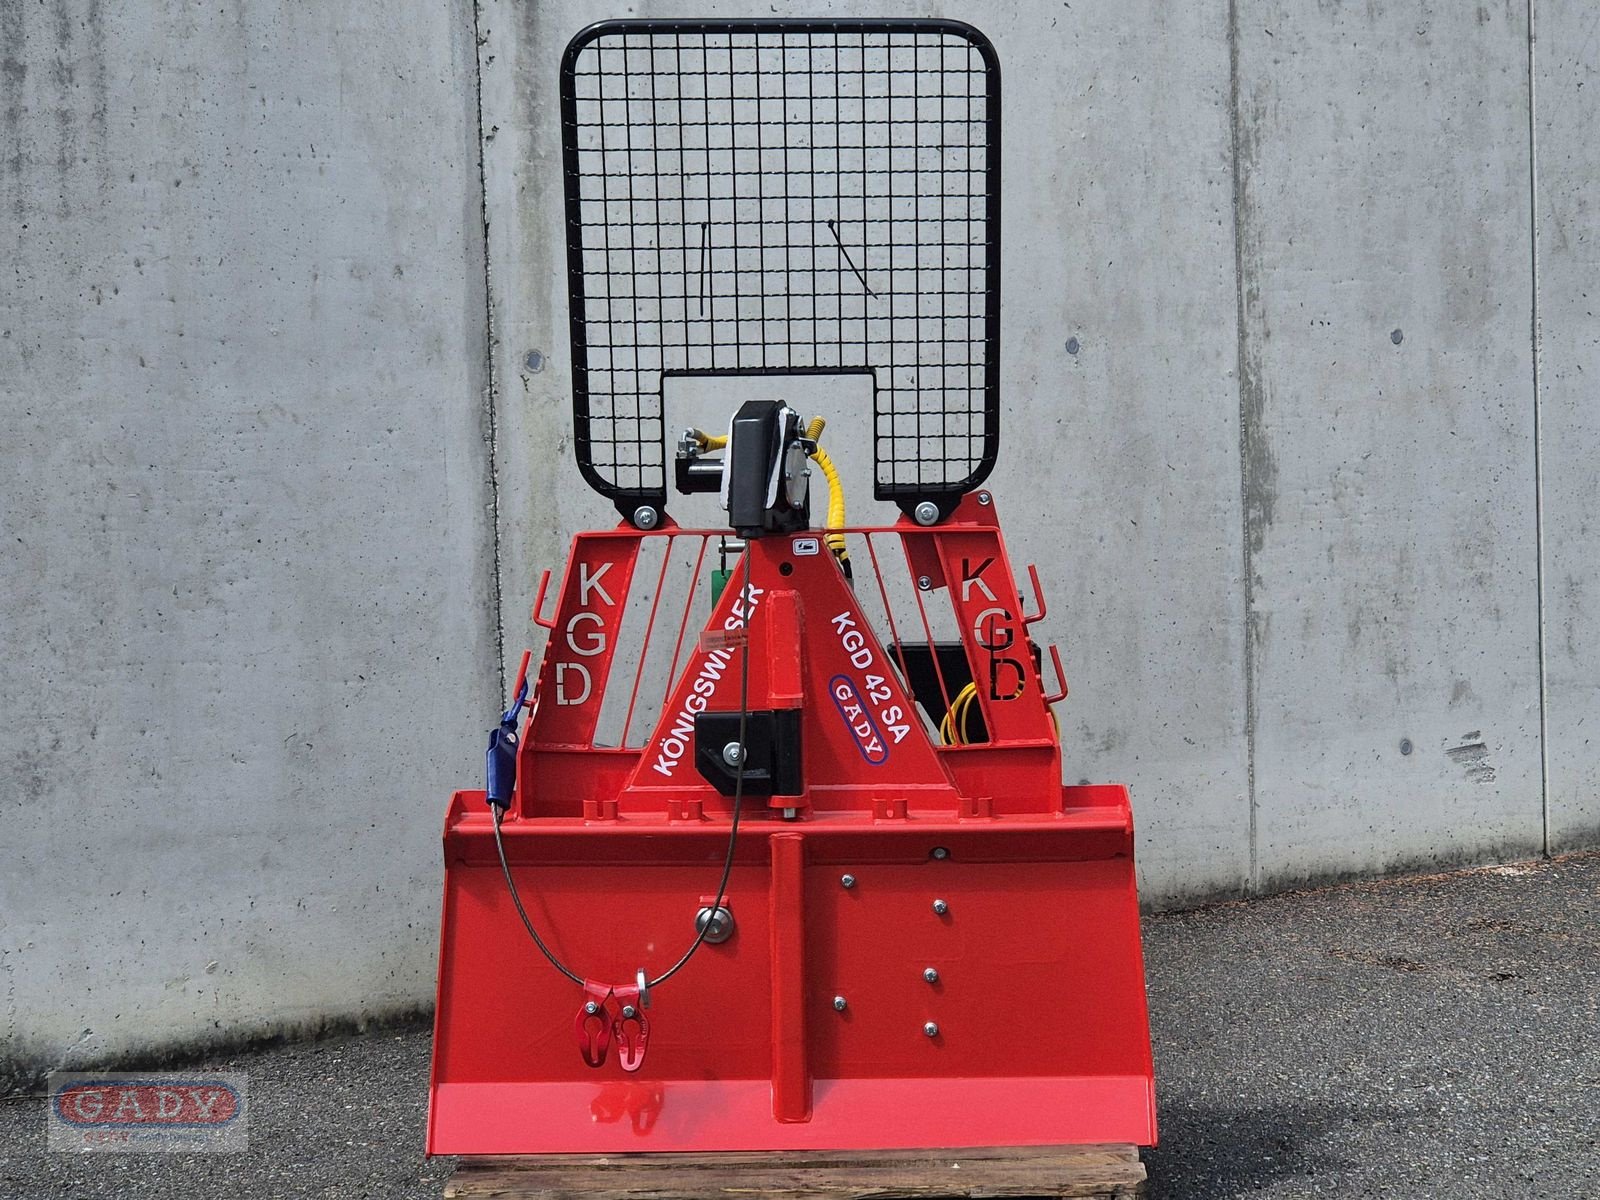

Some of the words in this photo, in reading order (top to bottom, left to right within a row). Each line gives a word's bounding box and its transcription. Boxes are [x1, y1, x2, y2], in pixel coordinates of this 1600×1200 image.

[556, 562, 616, 705] KGD
[653, 583, 764, 776] KÖNIGSWISER
[831, 611, 873, 669] KGD
[865, 674, 892, 705] 42
[881, 705, 910, 744] SA
[835, 684, 883, 753] GADY
